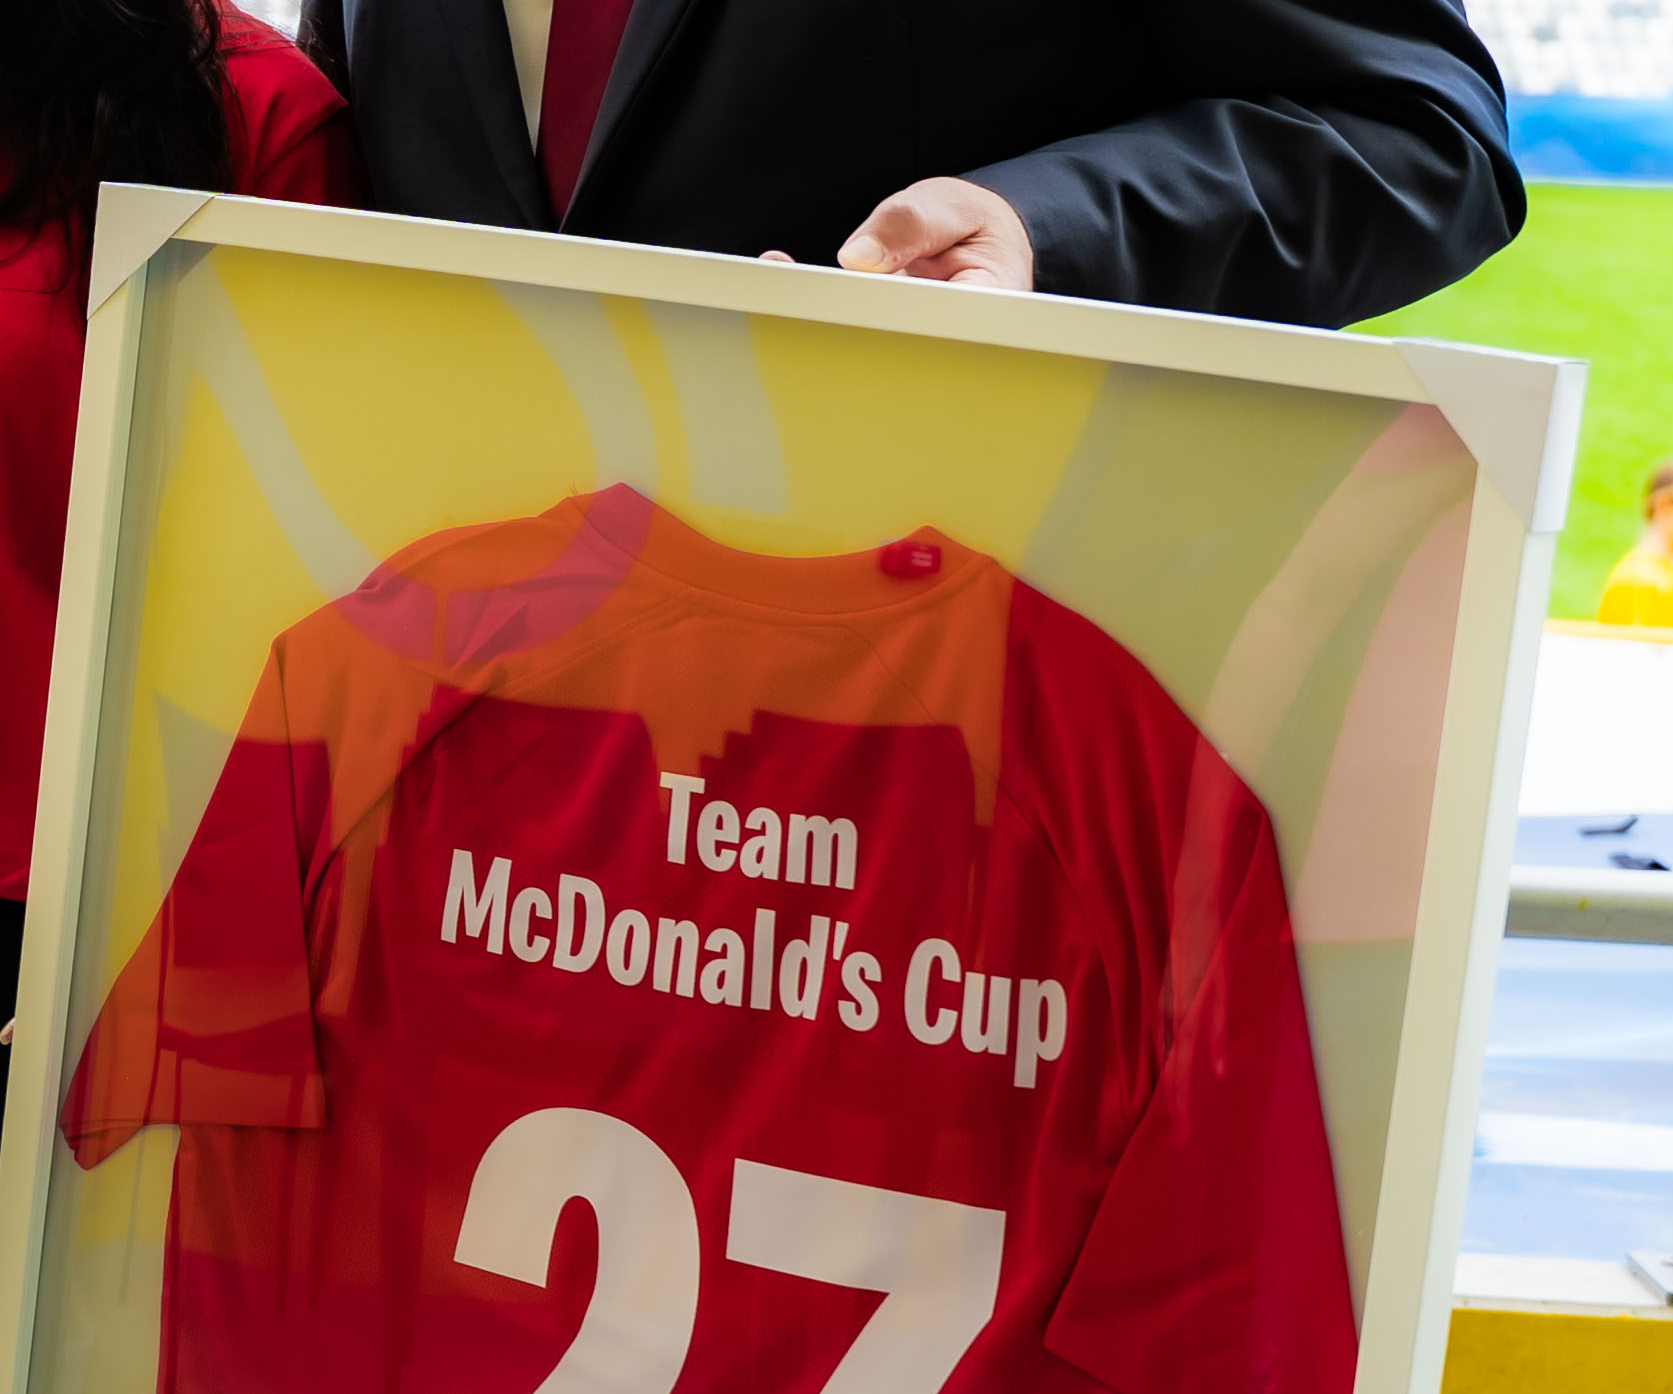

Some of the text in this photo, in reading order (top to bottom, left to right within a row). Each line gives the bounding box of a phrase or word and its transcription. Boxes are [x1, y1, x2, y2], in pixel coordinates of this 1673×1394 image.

[660, 772, 858, 890] Team
[442, 849, 1067, 1088] McDonald's Cup
